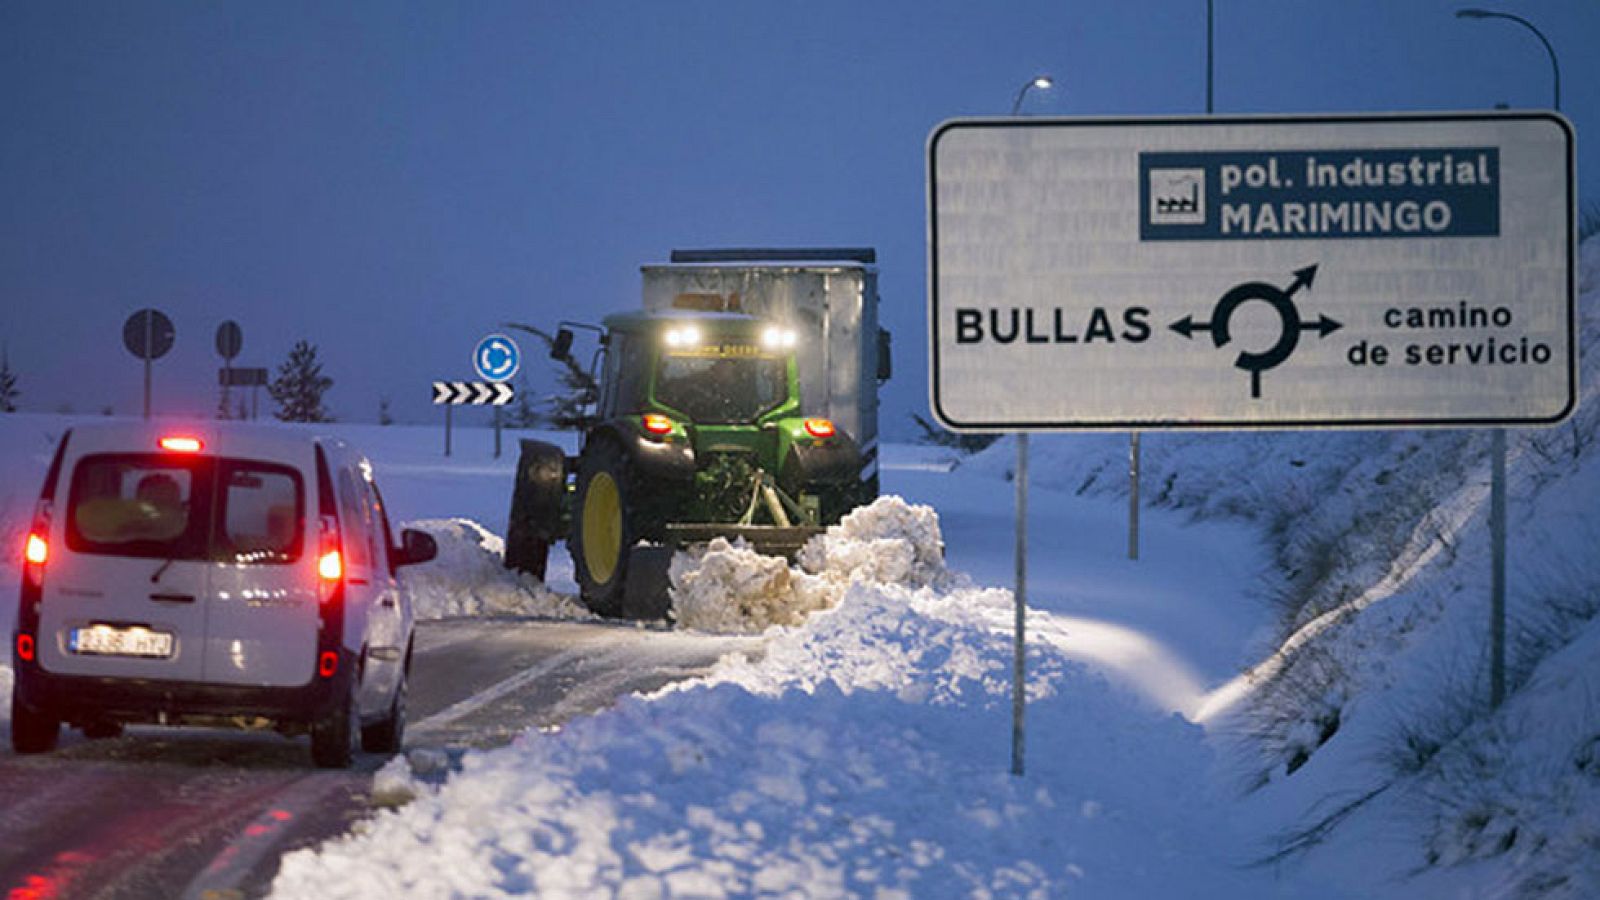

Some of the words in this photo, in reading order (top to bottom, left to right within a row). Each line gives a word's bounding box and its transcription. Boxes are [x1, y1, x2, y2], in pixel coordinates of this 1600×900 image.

[1221, 158, 1292, 192] pol.
[1308, 155, 1491, 187] industrial
[1221, 201, 1451, 234] MARIMINGO
[955, 307, 1152, 344] BULLAS
[1384, 301, 1512, 329] camino
[1348, 340, 1389, 366] de
[1406, 337, 1551, 366] servicio
